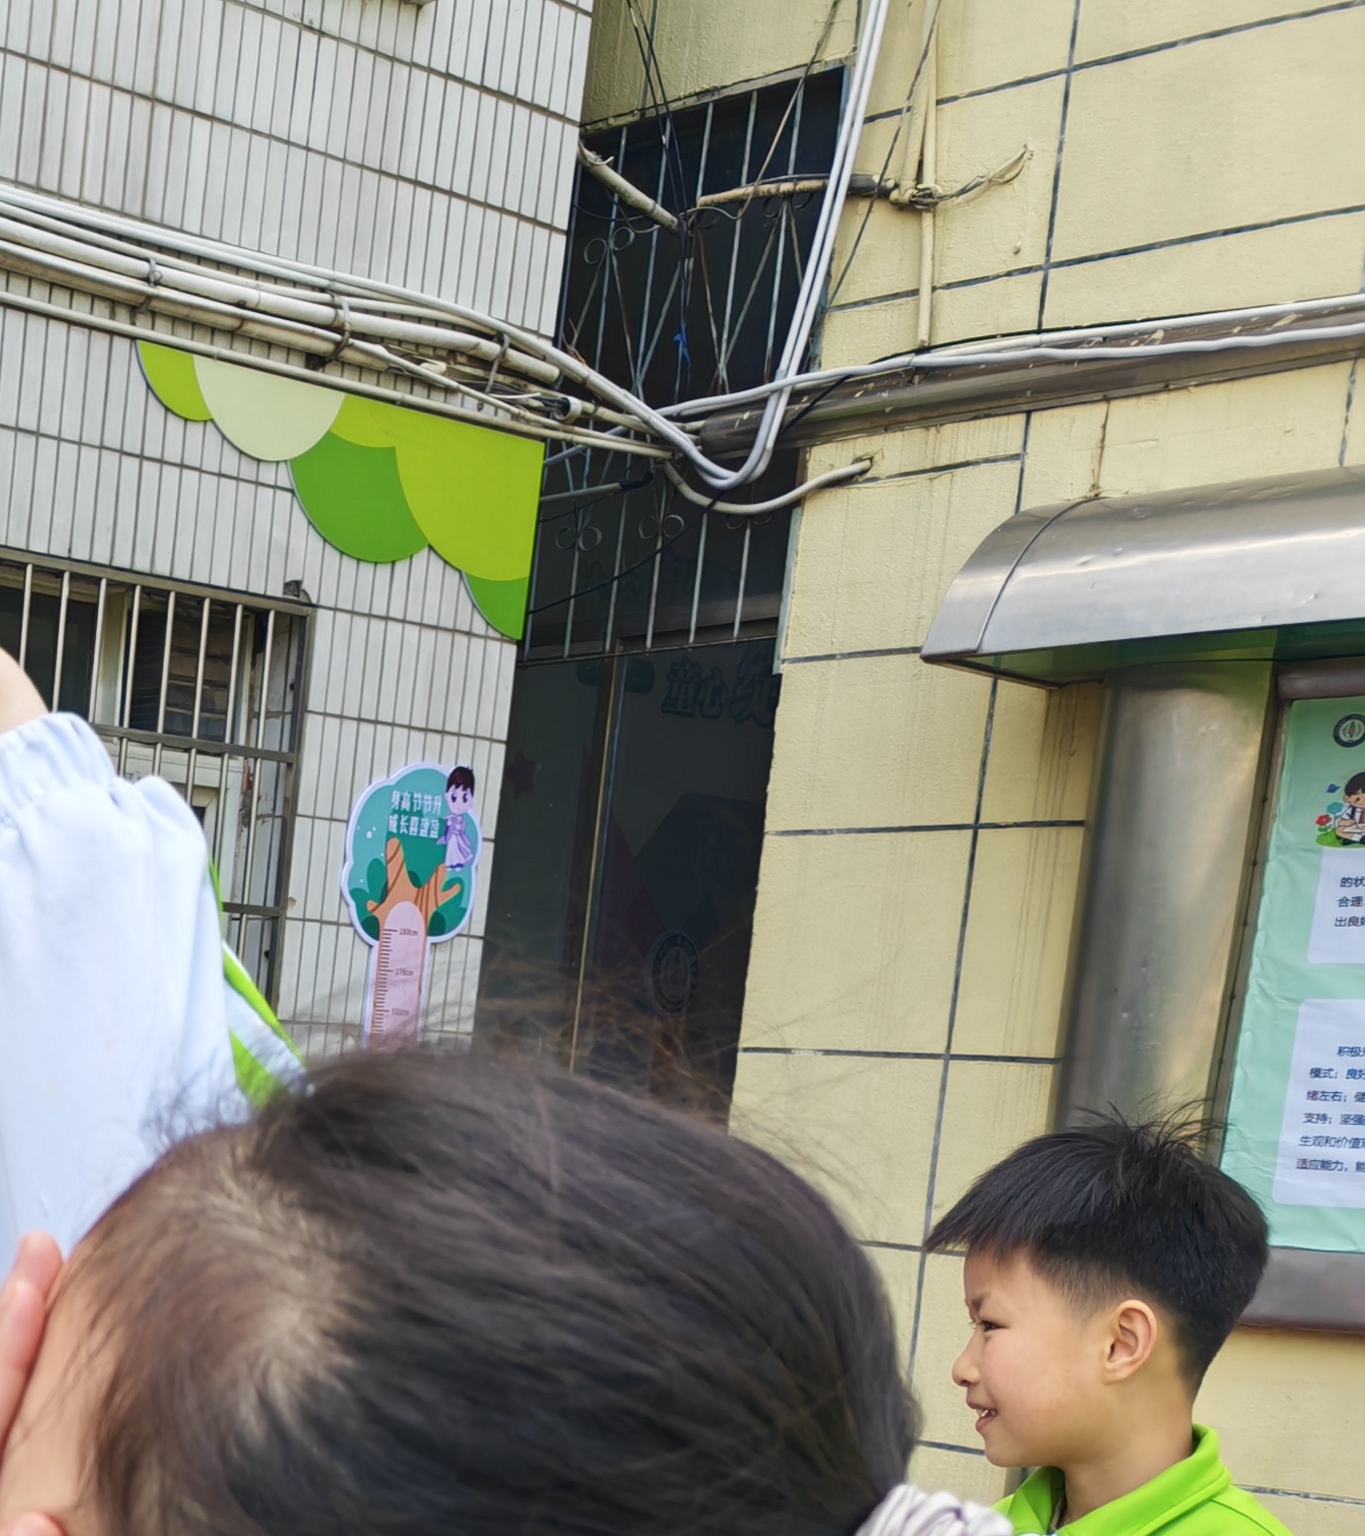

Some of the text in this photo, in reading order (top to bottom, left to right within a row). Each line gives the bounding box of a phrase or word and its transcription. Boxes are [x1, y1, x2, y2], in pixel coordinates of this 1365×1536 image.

[390, 790, 442, 816] 身高节节升
[388, 814, 439, 838] 成长喜盈盈
